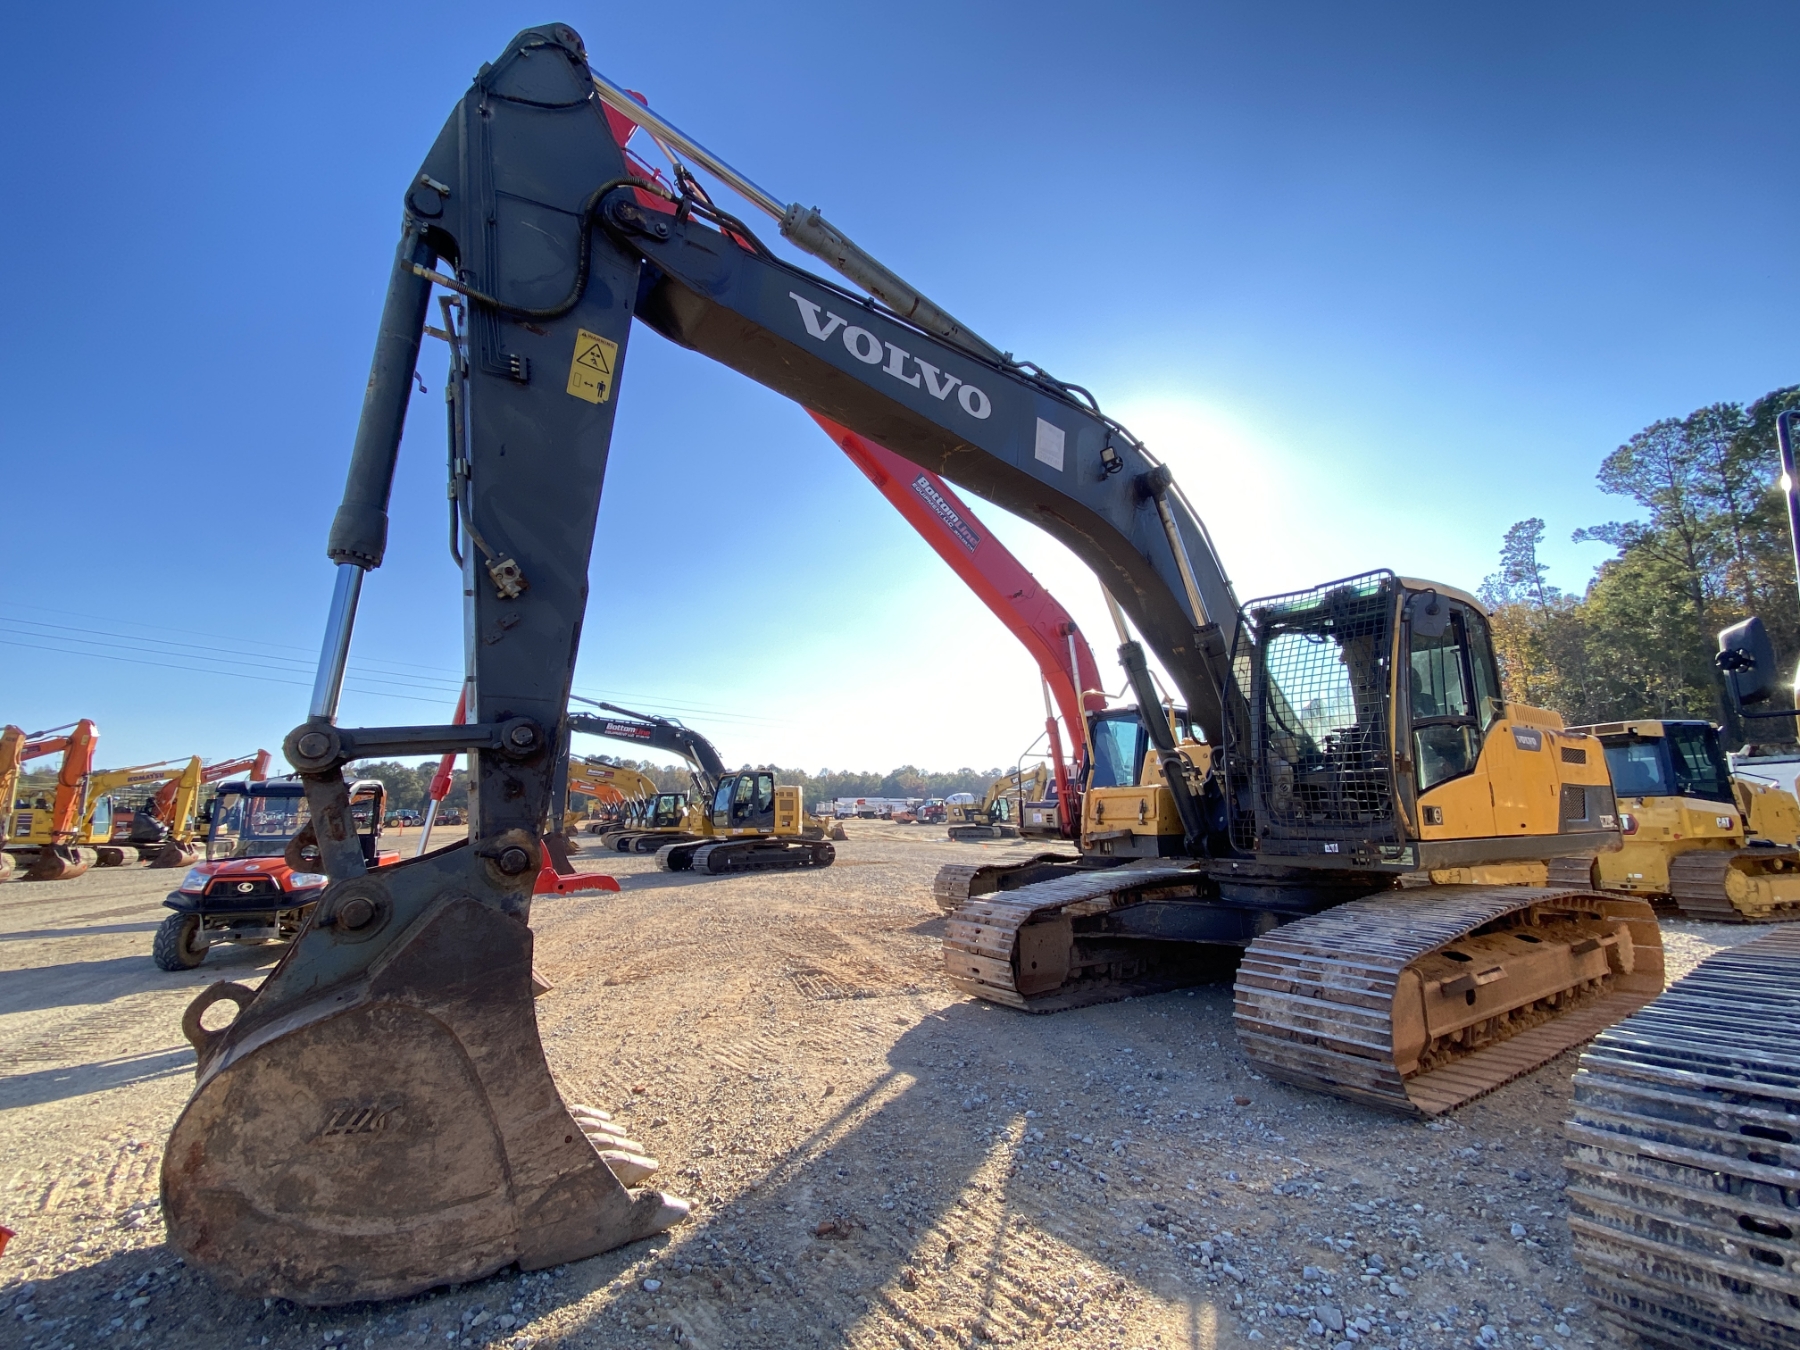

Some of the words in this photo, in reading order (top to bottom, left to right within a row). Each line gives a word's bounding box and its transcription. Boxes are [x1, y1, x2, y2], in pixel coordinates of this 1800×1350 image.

[588, 334, 615, 349] WARNING
[788, 291, 992, 420] VOLVO
[911, 483, 946, 518] EQUIPMENT
[943, 514, 954, 528] LLC
[1515, 735, 1538, 746] VOLVO
[127, 772, 165, 782] KOMATSU
[1716, 816, 1730, 827] CAT
